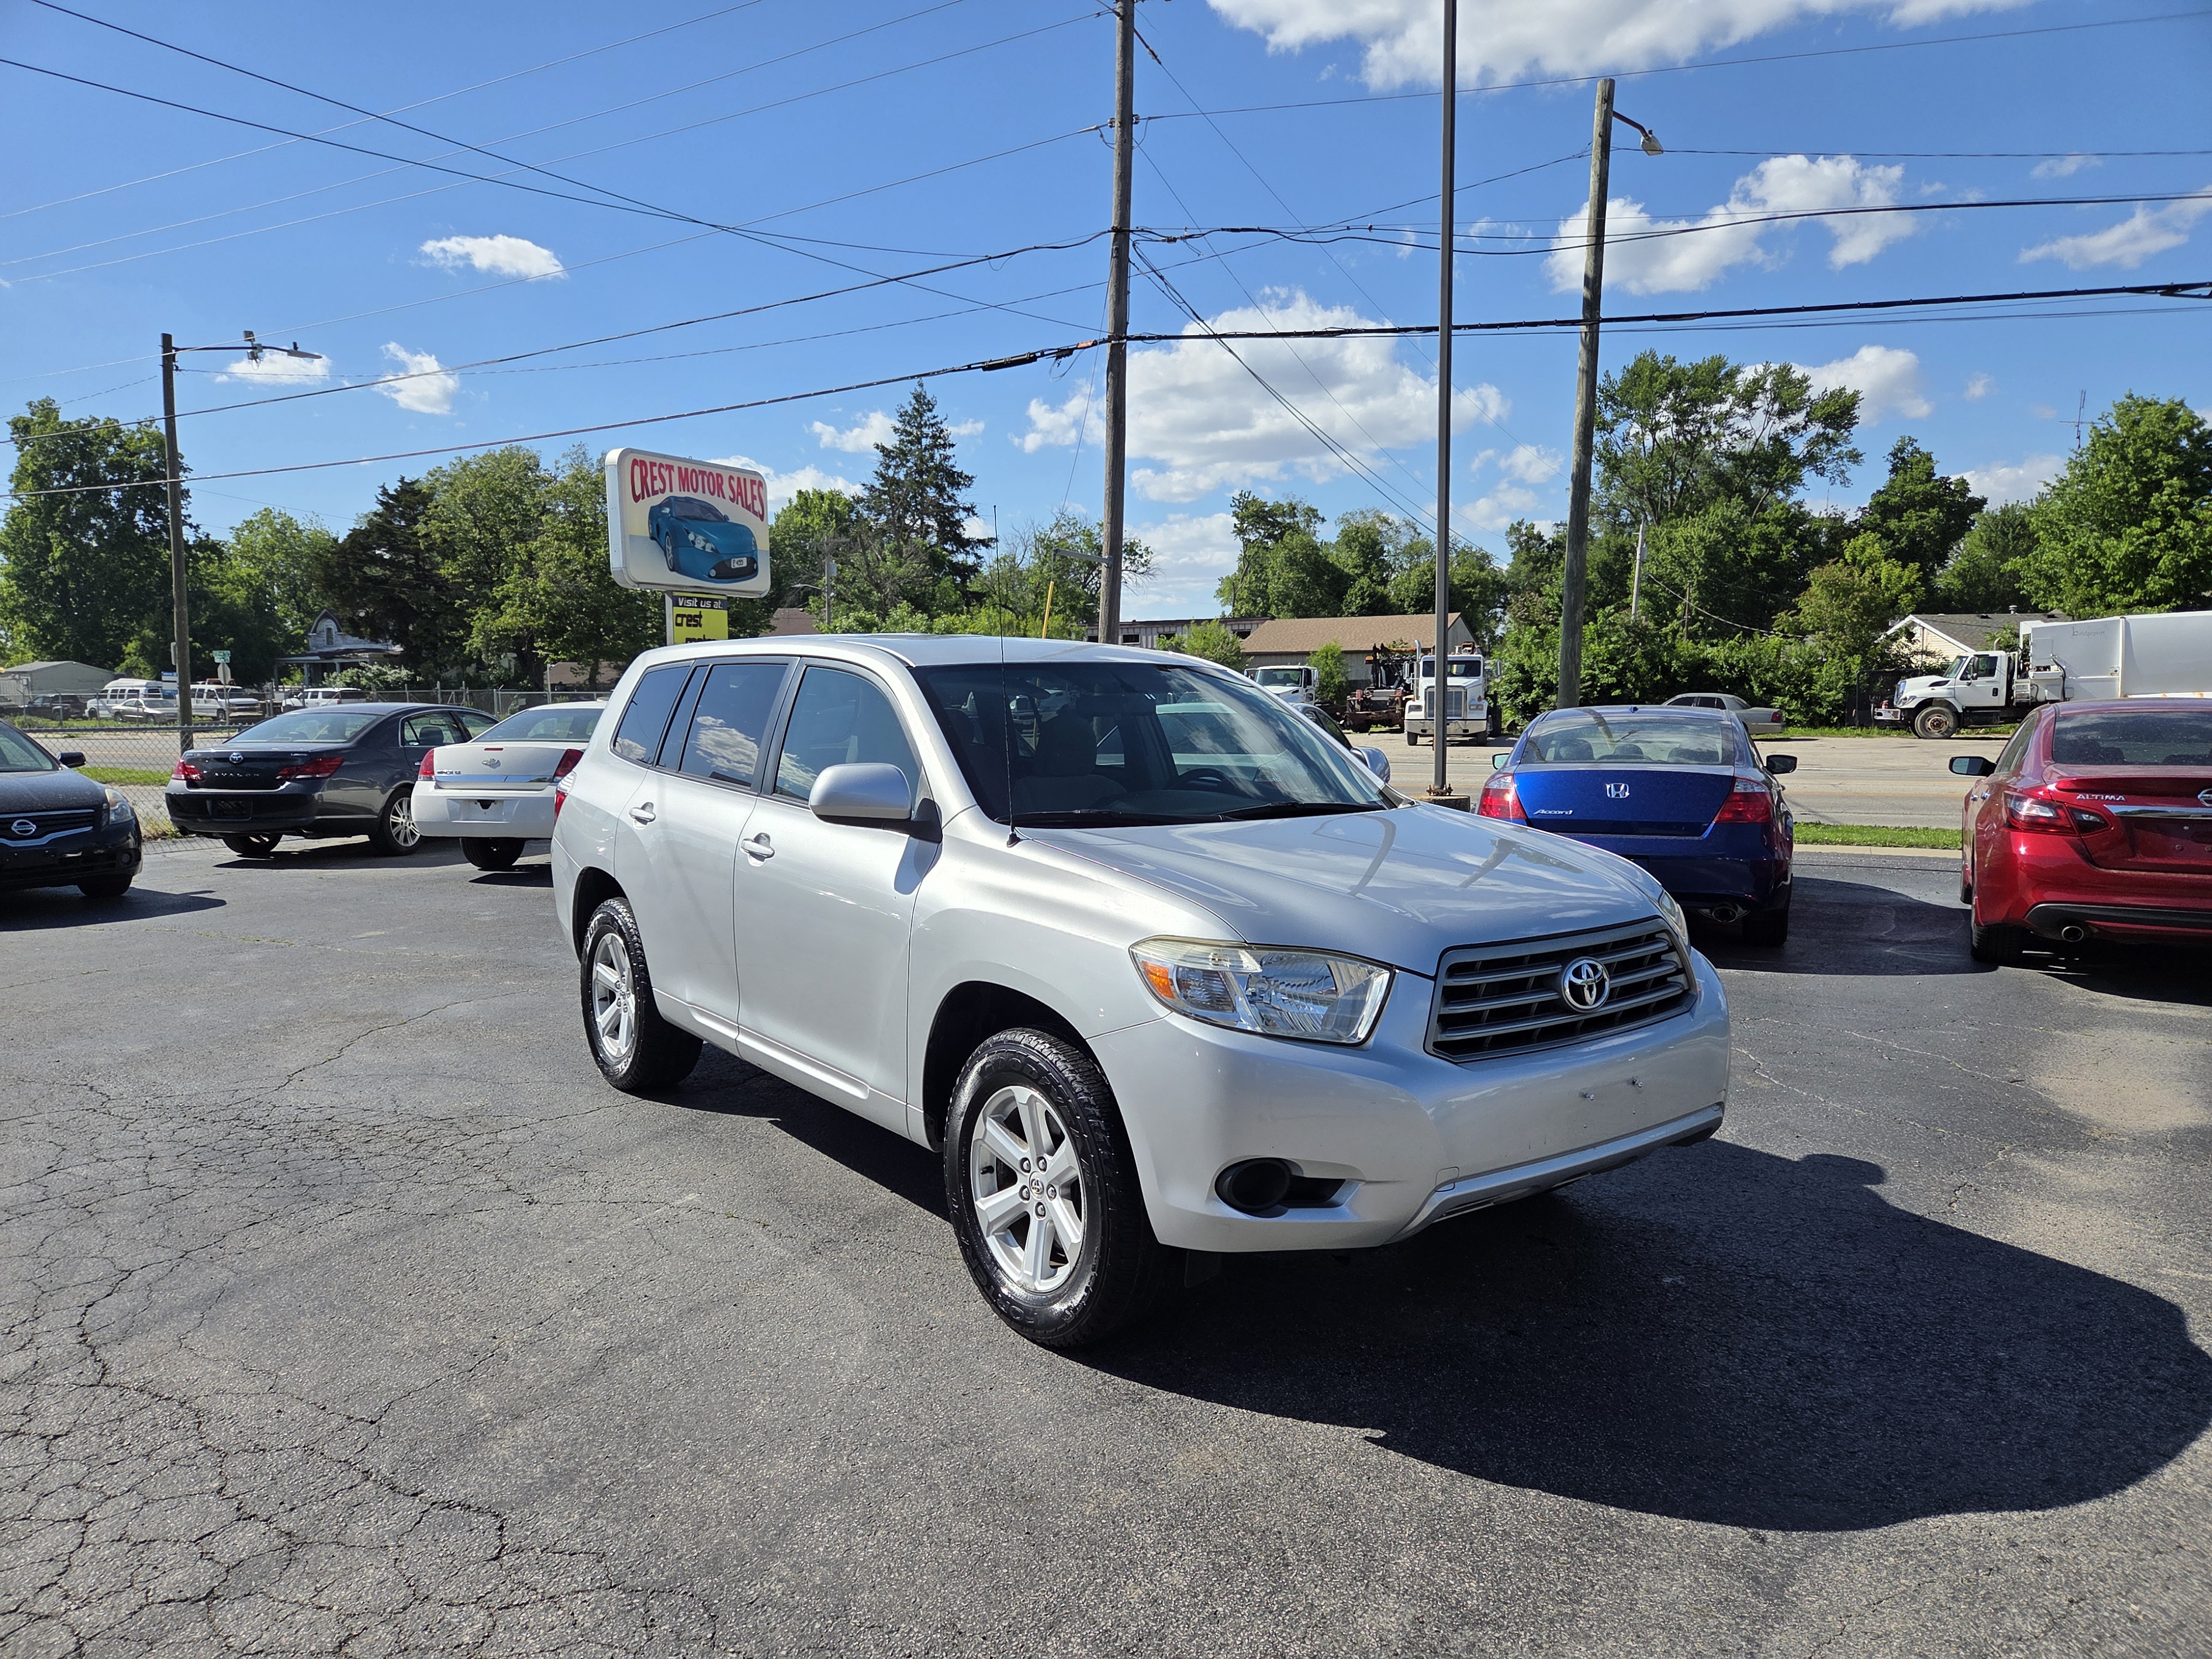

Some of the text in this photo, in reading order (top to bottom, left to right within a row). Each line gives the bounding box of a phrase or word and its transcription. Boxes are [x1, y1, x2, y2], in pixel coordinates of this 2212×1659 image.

[630, 458, 765, 522] CREST MOTOR SALES
[678, 597, 698, 607] Visit
[713, 600, 723, 609] at:
[675, 611, 703, 628] crest
